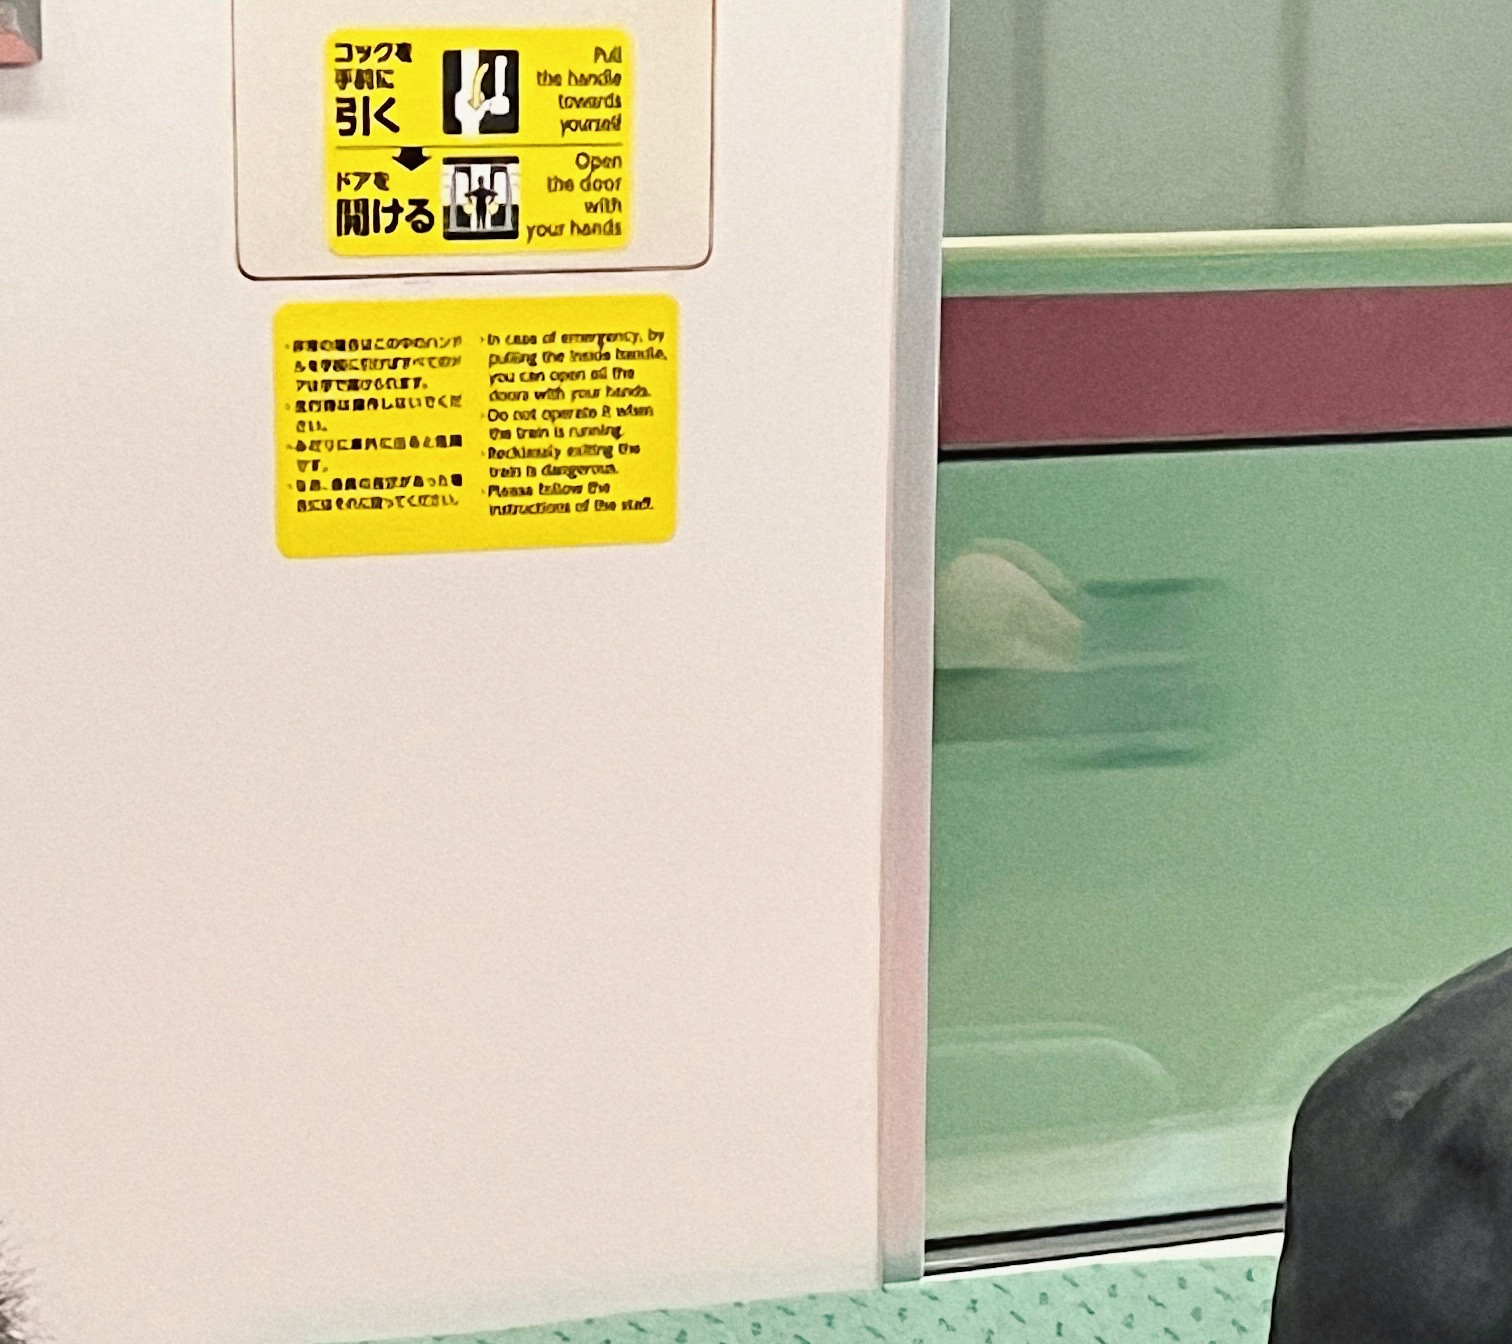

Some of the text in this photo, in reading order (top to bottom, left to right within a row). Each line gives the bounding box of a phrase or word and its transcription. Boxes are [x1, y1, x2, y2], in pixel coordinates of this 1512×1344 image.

[537, 69, 622, 86] the handle
[559, 92, 622, 109] towards
[335, 96, 400, 136] 引く
[560, 113, 621, 138] yourself
[575, 151, 622, 174] Open
[547, 175, 622, 193] the door
[584, 197, 622, 213] with
[336, 198, 435, 237] 開ける
[526, 218, 622, 245] your hands
[648, 328, 664, 342] by
[542, 351, 564, 362] the
[490, 373, 514, 385] you
[520, 372, 544, 381] can
[550, 371, 585, 384] open
[613, 367, 634, 379] the
[535, 387, 564, 399] with
[571, 389, 600, 402] your
[488, 409, 508, 421] Do
[513, 409, 536, 420] not
[542, 408, 597, 422] operate
[489, 428, 511, 440] the
[517, 427, 548, 439] train
[555, 427, 564, 438] is
[619, 444, 640, 454] the
[489, 467, 521, 477] train
[588, 482, 610, 494] the
[575, 499, 590, 512] of
[595, 500, 616, 511] the
